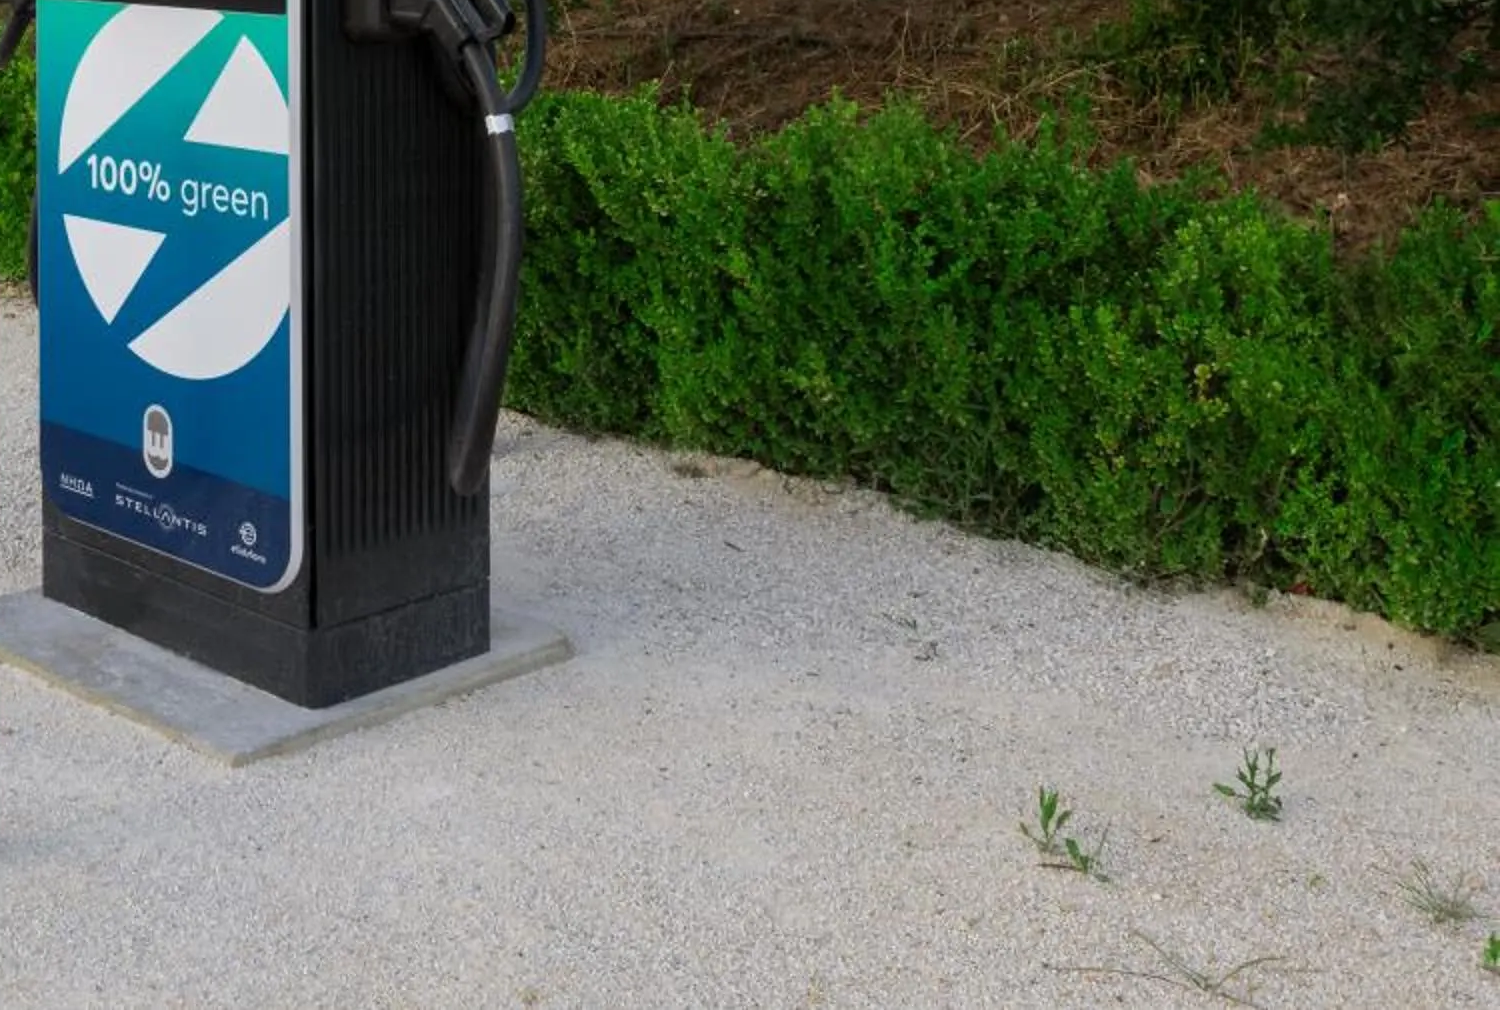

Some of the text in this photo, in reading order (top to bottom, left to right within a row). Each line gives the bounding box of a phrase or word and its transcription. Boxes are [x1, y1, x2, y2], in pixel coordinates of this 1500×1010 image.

[87, 153, 269, 221] 100% green
[115, 494, 207, 536] STELLANTIS
